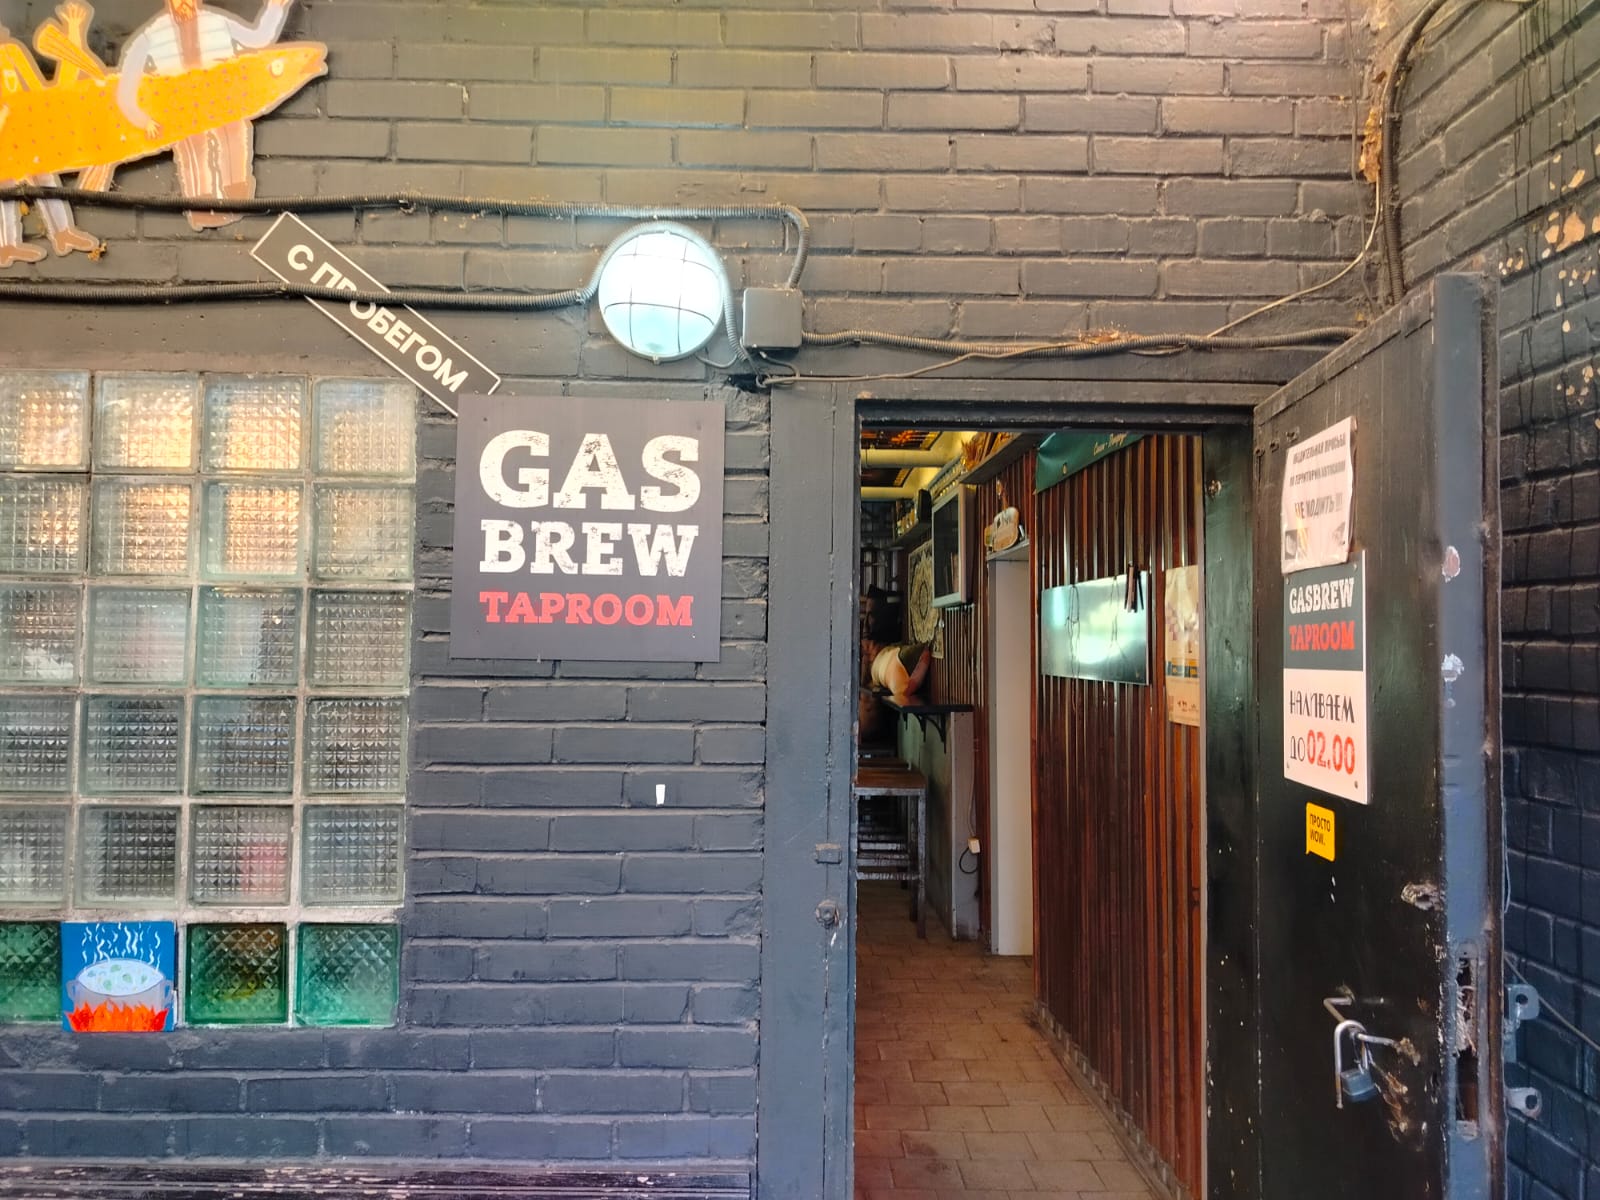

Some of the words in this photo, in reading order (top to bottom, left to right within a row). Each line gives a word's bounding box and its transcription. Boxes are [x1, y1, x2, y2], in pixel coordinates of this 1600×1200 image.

[287, 244, 314, 271] С
[479, 429, 701, 512] GAS
[479, 519, 699, 576] BREW
[479, 591, 694, 626] TAPROOM
[1289, 577, 1354, 614] GASBREW
[1289, 621, 1355, 651] TAPROOM
[1290, 690, 1354, 723] НАЛИВАЕМ
[1307, 729, 1355, 775] 02.00
